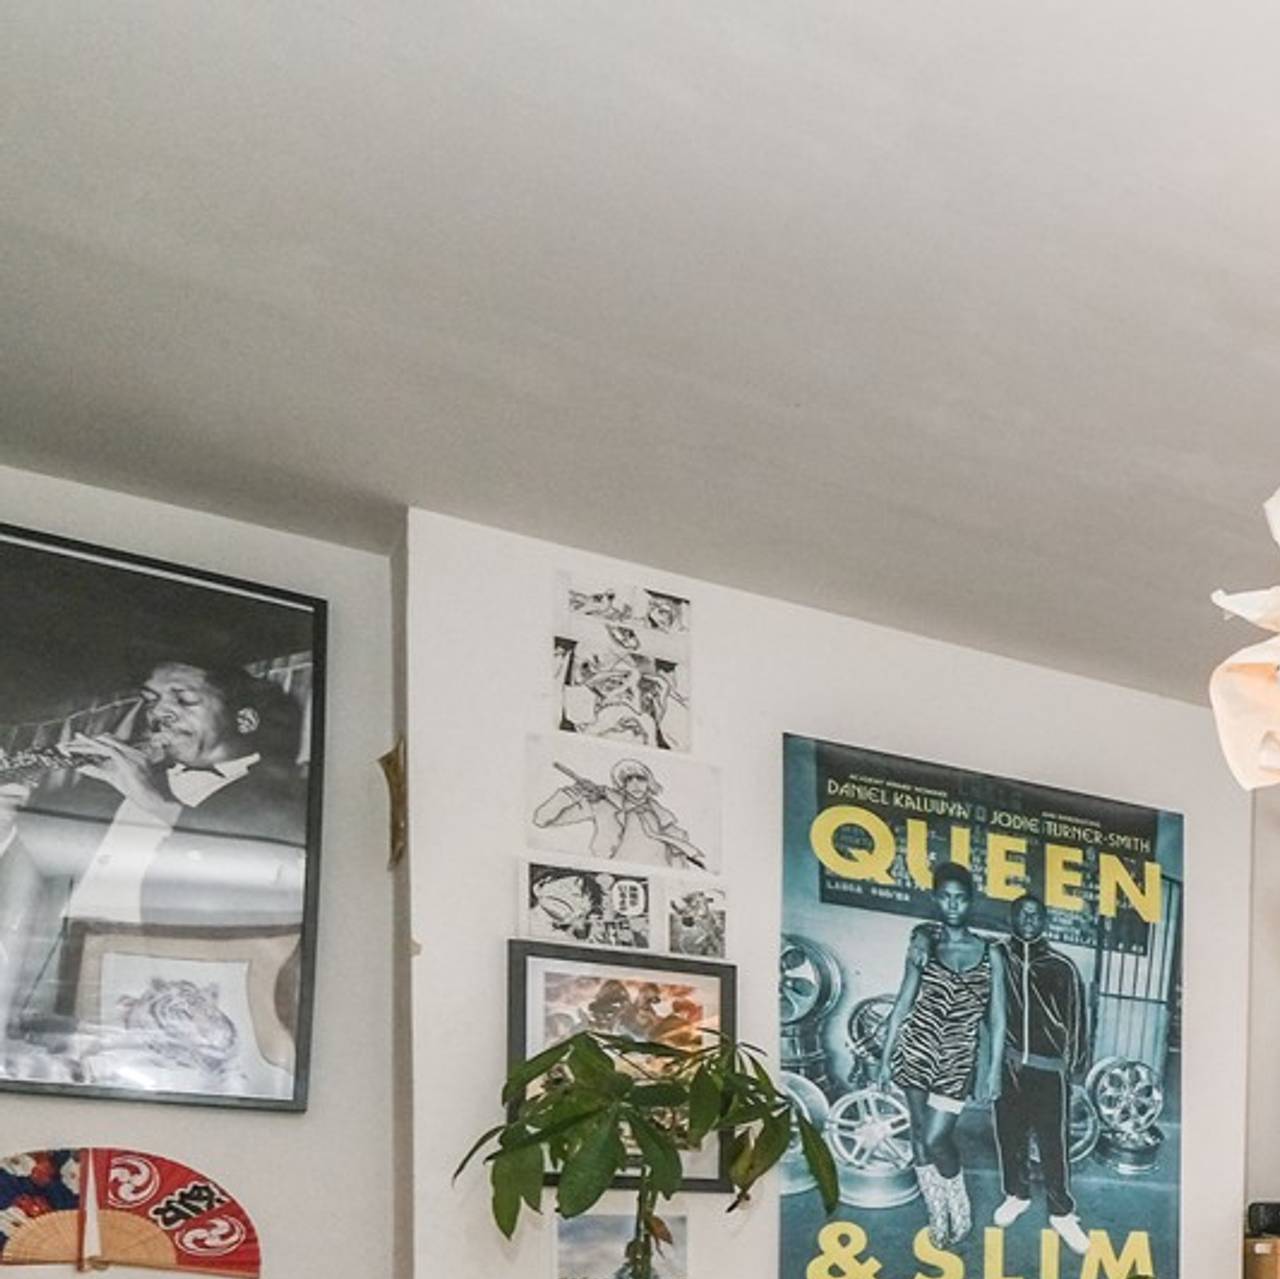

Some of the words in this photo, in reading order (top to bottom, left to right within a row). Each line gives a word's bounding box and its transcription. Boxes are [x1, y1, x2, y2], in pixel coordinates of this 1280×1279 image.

[827, 779, 889, 805] DANIEL
[990, 811, 1040, 834] JODIE
[1044, 820, 1151, 852] TURNER-SMITH
[809, 805, 1163, 923] QUEEN
